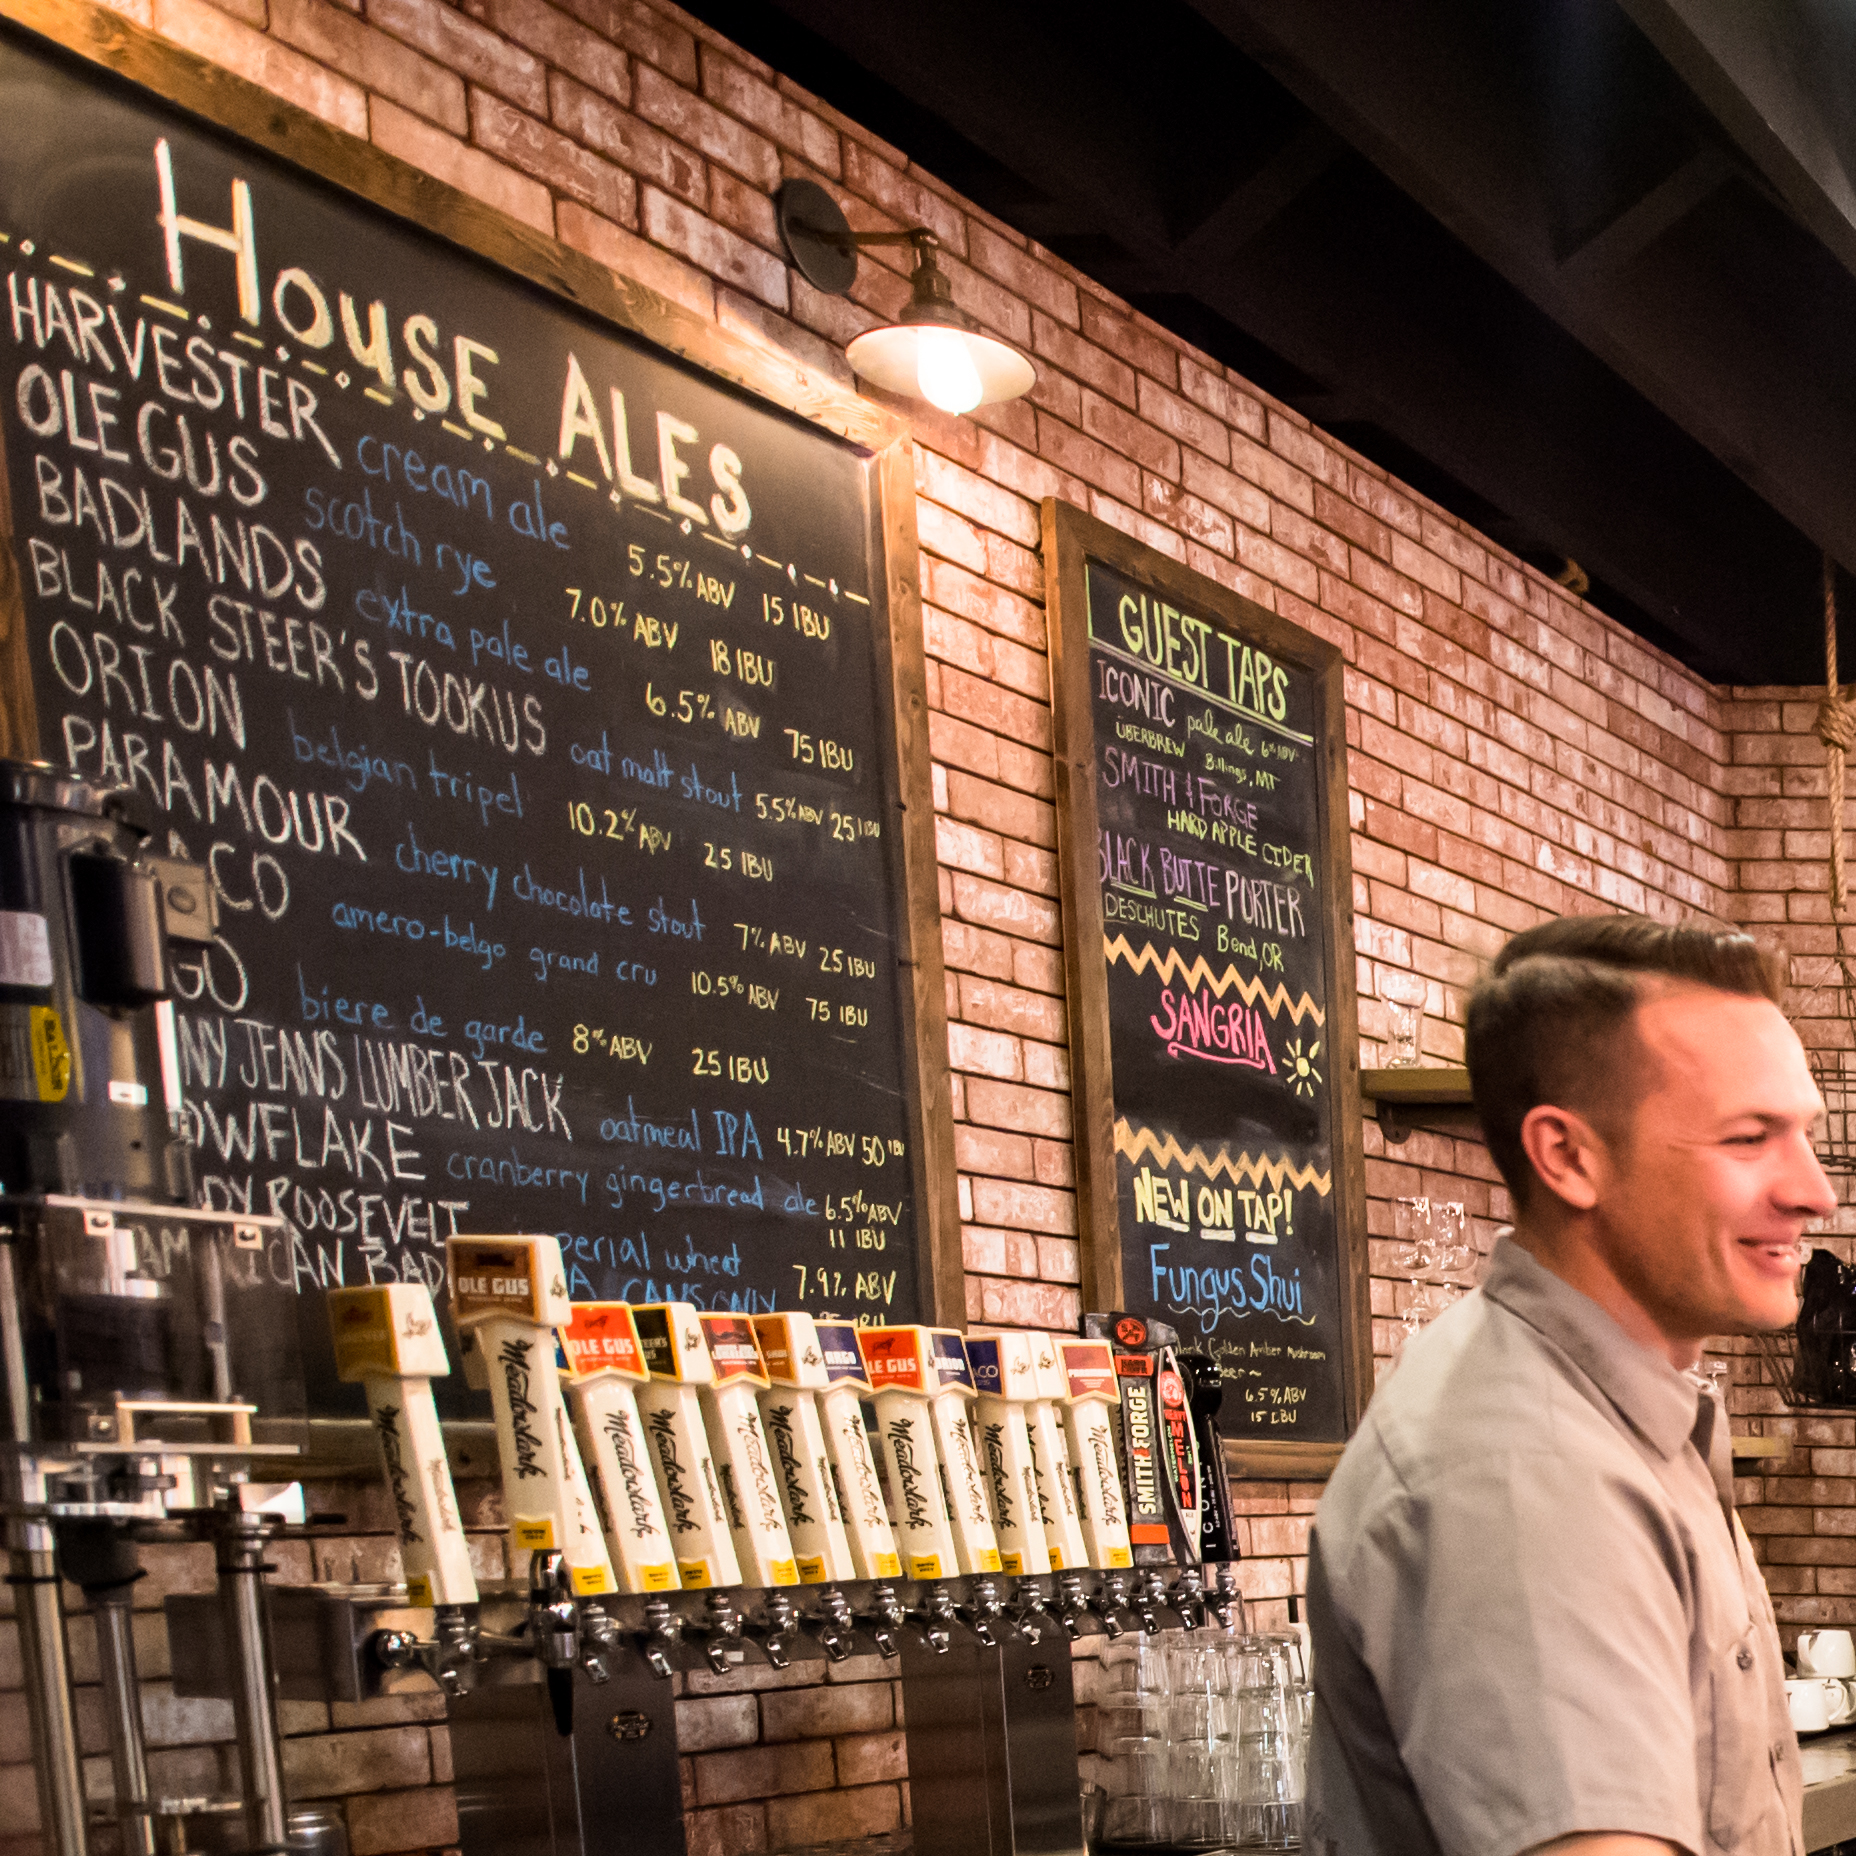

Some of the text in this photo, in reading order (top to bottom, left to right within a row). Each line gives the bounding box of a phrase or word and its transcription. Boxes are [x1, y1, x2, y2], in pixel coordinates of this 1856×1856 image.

[8, 271, 830, 641] HARVESTER cream ale 5.5% ABV 15 IBU
[558, 350, 752, 540] ALES
[16, 362, 774, 687] OLE GUS scotch rye 7.0% ABV 18 IBU
[35, 453, 854, 772] BADLANDS extra pale ale 6.5% ABV 75 IBU
[1118, 594, 1290, 722] GUEST TAPS
[28, 537, 187, 647] BLACK
[207, 593, 380, 701] STEER'S
[387, 650, 547, 757] TOOKUS
[570, 731, 613, 776] oat
[621, 748, 674, 788] malt
[680, 763, 743, 813] stout
[755, 794, 797, 824] 5.5%
[798, 804, 824, 829] ABV
[830, 812, 855, 844] 25
[1096, 658, 1255, 756] ICONIC pale ale
[50, 620, 775, 882] ORION belgian tripel 10.2% ABV 25 IBU
[1101, 746, 1259, 832] SMITH FORGE
[1255, 769, 1282, 791] MT
[62, 713, 876, 979] PARAMOUR cherry chocolate stout 7% ABV 25 IBU
[1159, 847, 1221, 908] BUTTE
[1225, 869, 1307, 938] PORTER
[1166, 809, 1315, 890] HARD APPLE CIDER
[1104, 891, 1200, 942] DESCHUTES
[331, 901, 869, 1028] amero-belgo grand cru 10.5% ABV 75 IBU
[296, 960, 770, 1086] biere de garde 8% ABV 25 IBU
[1150, 988, 1278, 1075] SANGRIA
[233, 1016, 348, 1101] JEANS
[600, 1094, 701, 1152] oatmeal
[712, 1108, 764, 1161] IPA
[776, 1126, 825, 1158] 4.7%
[827, 1130, 856, 1158] ABV
[862, 1136, 886, 1168] 50
[446, 1147, 589, 1205] cranberry
[605, 1163, 765, 1213] gingerbread
[784, 1181, 820, 1216] ale
[825, 1189, 868, 1223] 6.5%
[868, 1201, 903, 1226] ABV
[1133, 1166, 1294, 1236] NEW ON TAP!
[265, 1175, 471, 1250] ROOSEVELT
[664, 1233, 742, 1277] wheat
[855, 1269, 897, 1306] ABV
[491, 1276, 530, 1296] GUS
[829, 1226, 886, 1251] 11 IBU
[1150, 1242, 1303, 1334] Fungus Shui
[572, 1338, 600, 1356] OLE
[602, 1337, 636, 1356] GUS
[886, 1357, 917, 1374] GUS
[1249, 1340, 1282, 1358] Amber
[499, 1338, 549, 1480] Meadowlark
[1127, 1386, 1151, 1450] FORGE
[1250, 1410, 1268, 1423] 15
[1283, 1386, 1308, 1404] ABV
[604, 1409, 661, 1540] Meadowlark
[649, 1409, 702, 1534] Meadowlark
[769, 1404, 815, 1528] Meadowlark
[888, 1417, 934, 1530] Meadowlark
[1134, 1453, 1157, 1517] SMITH
